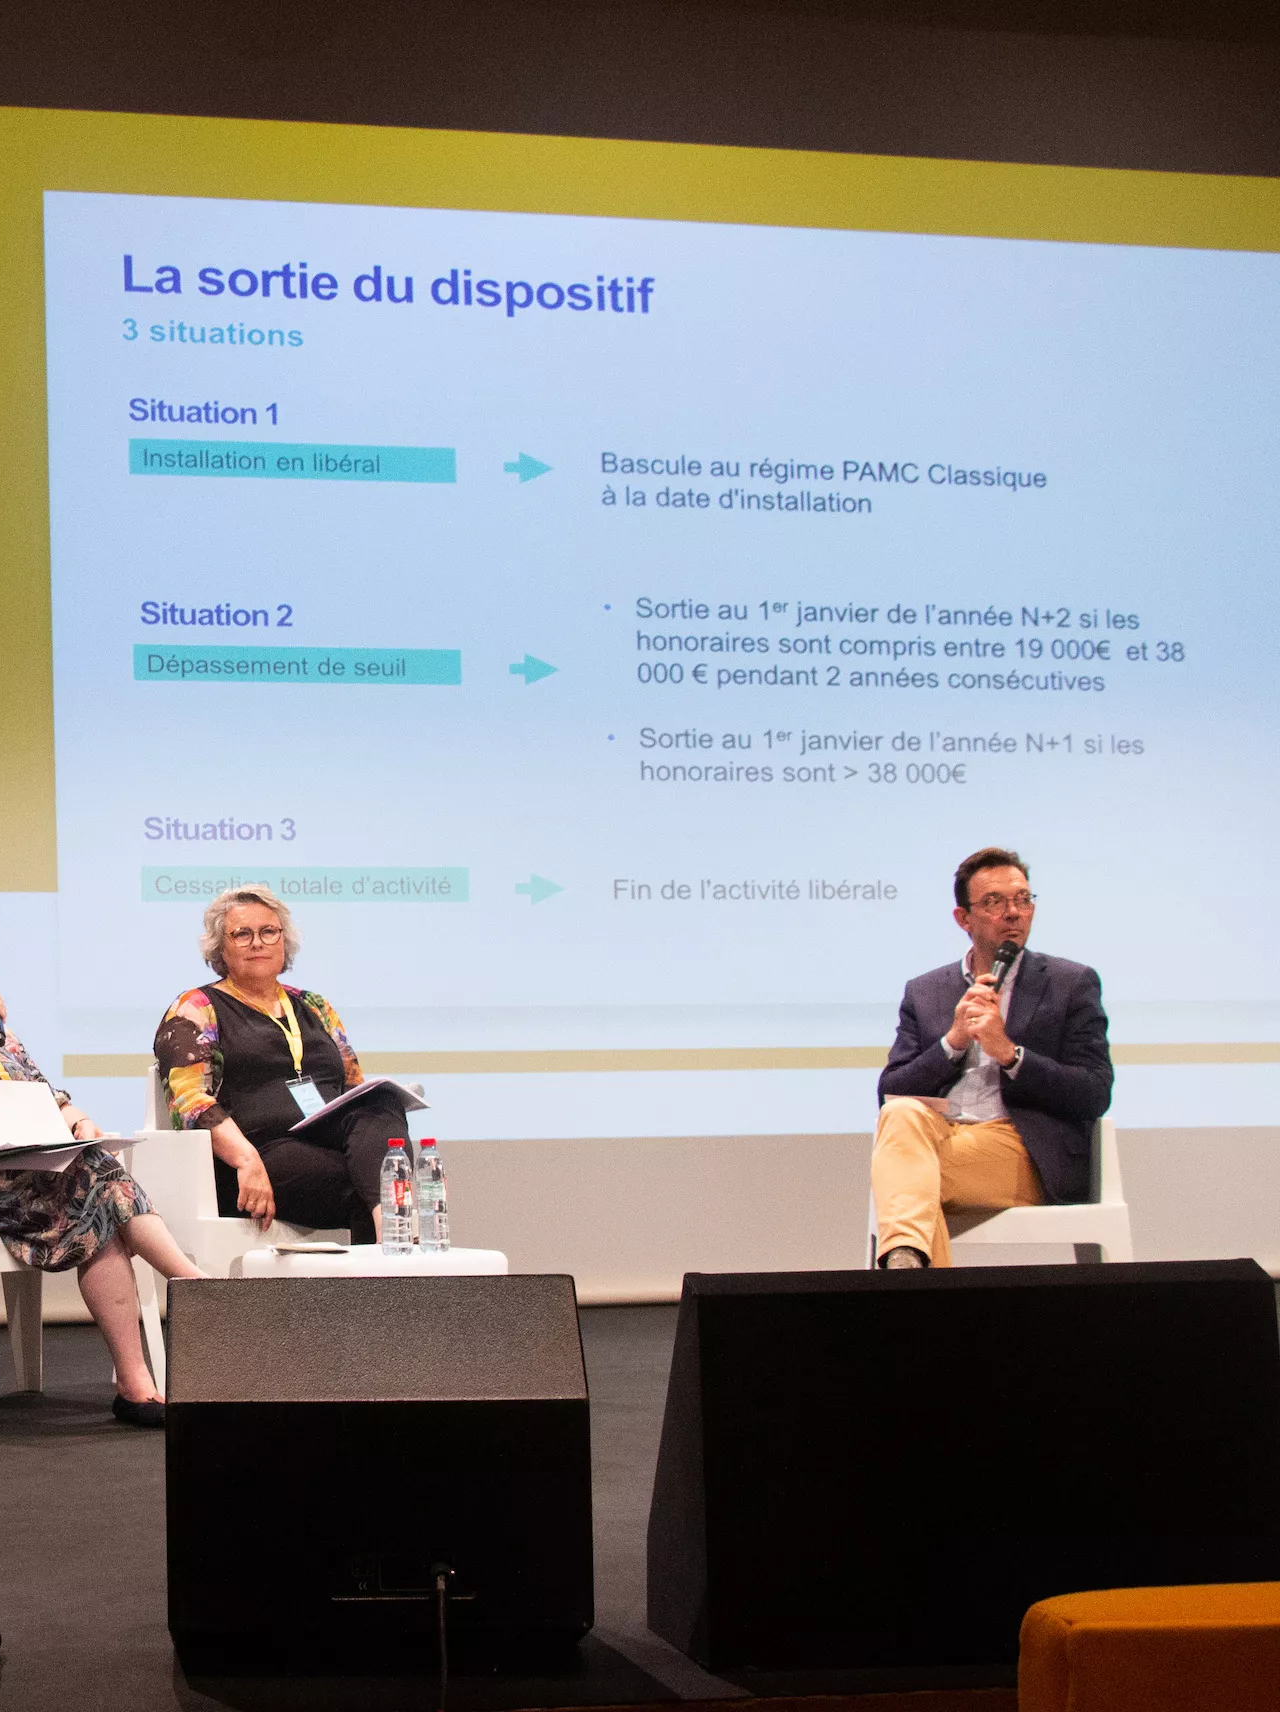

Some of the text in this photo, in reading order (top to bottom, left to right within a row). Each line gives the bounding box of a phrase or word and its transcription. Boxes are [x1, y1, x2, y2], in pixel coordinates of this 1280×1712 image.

[124, 255, 655, 317] La sortie du dispositif
[123, 318, 303, 347] 3 situations
[129, 398, 277, 425] Situation 1
[144, 448, 380, 473] Installation en libéral
[601, 452, 1047, 492] Bascule au régime PAMC Classique
[602, 485, 872, 513] à la date d'installation
[141, 601, 292, 627] Situation 2
[636, 597, 710, 619] Sortie
[718, 605, 747, 620] au
[796, 601, 879, 627] janvier
[887, 604, 917, 624] de
[1022, 607, 1070, 628] N+2
[1080, 609, 1098, 629] si
[1106, 609, 1140, 630] les
[637, 630, 1185, 662] honoraires sont compris entre 19 000€ et 38
[148, 654, 405, 678] Dépassement de seuil
[638, 662, 1105, 691] 000 € pendant 2 années consécutives
[640, 727, 713, 749] Sortie
[722, 734, 751, 749] au
[800, 730, 883, 755] janvier
[892, 731, 921, 751] de
[1026, 733, 1071, 752] N+1
[1084, 734, 1102, 754] si
[1111, 735, 1144, 755] les
[640, 760, 966, 784] honoraires sont > 38 000€
[144, 817, 296, 841] Situation 3
[155, 874, 271, 895] Cessati
[281, 876, 343, 895] totale
[614, 879, 651, 900] Fin
[661, 880, 691, 900] de
[809, 880, 897, 900] libérale
